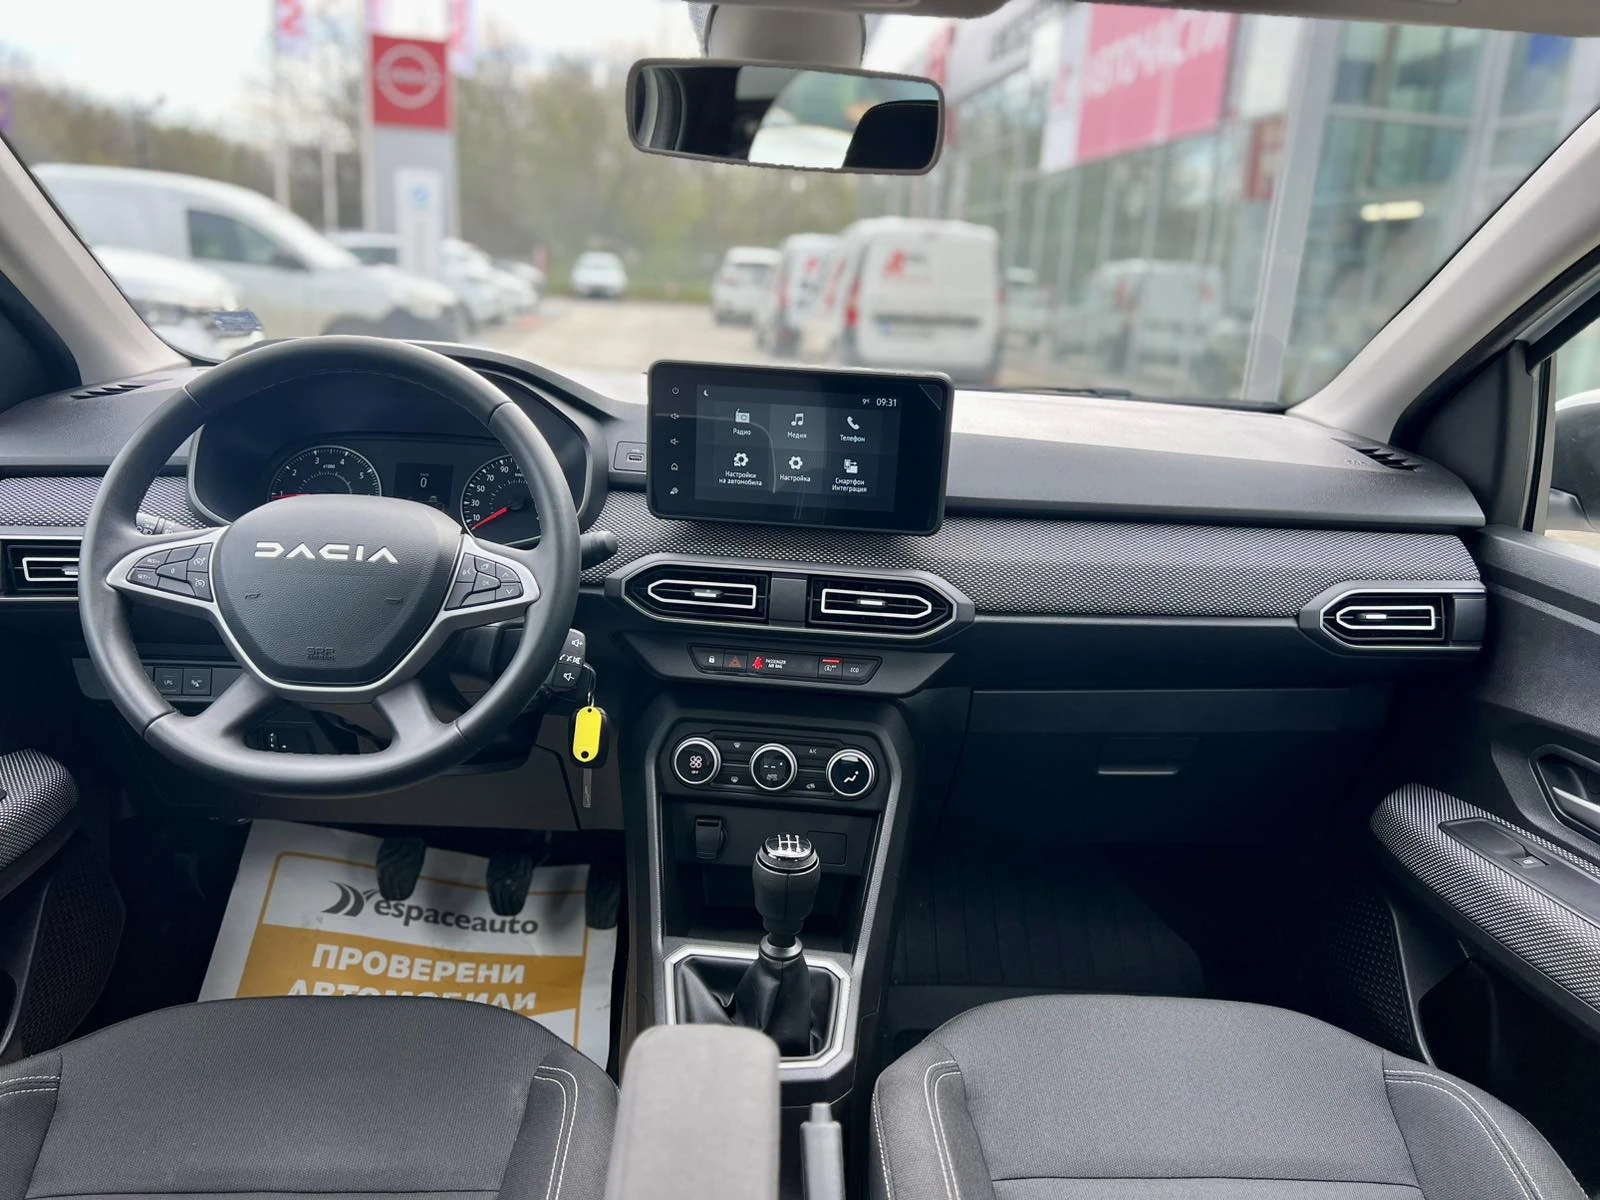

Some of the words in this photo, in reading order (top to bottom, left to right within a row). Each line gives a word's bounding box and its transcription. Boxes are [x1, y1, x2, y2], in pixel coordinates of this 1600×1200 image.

[876, 398, 897, 407] 09:31
[732, 428, 752, 436] Радио
[839, 434, 866, 443] Телефон
[314, 457, 320, 465] 3
[291, 469, 297, 477] 2
[359, 472, 365, 480] 5
[725, 470, 757, 479] Настройки
[420, 477, 428, 488] 0
[486, 474, 495, 482] 70
[727, 478, 763, 486] автомобила
[779, 474, 811, 483] Настройка
[835, 477, 865, 487] Смартфон
[476, 485, 486, 493] 50
[832, 484, 868, 493] Интеграция
[470, 499, 480, 507] 30
[472, 513, 481, 521] 10
[254, 542, 399, 563] DACIA
[373, 899, 539, 934] espaceauto
[311, 943, 526, 985] ПРОВЕРЕНИ
